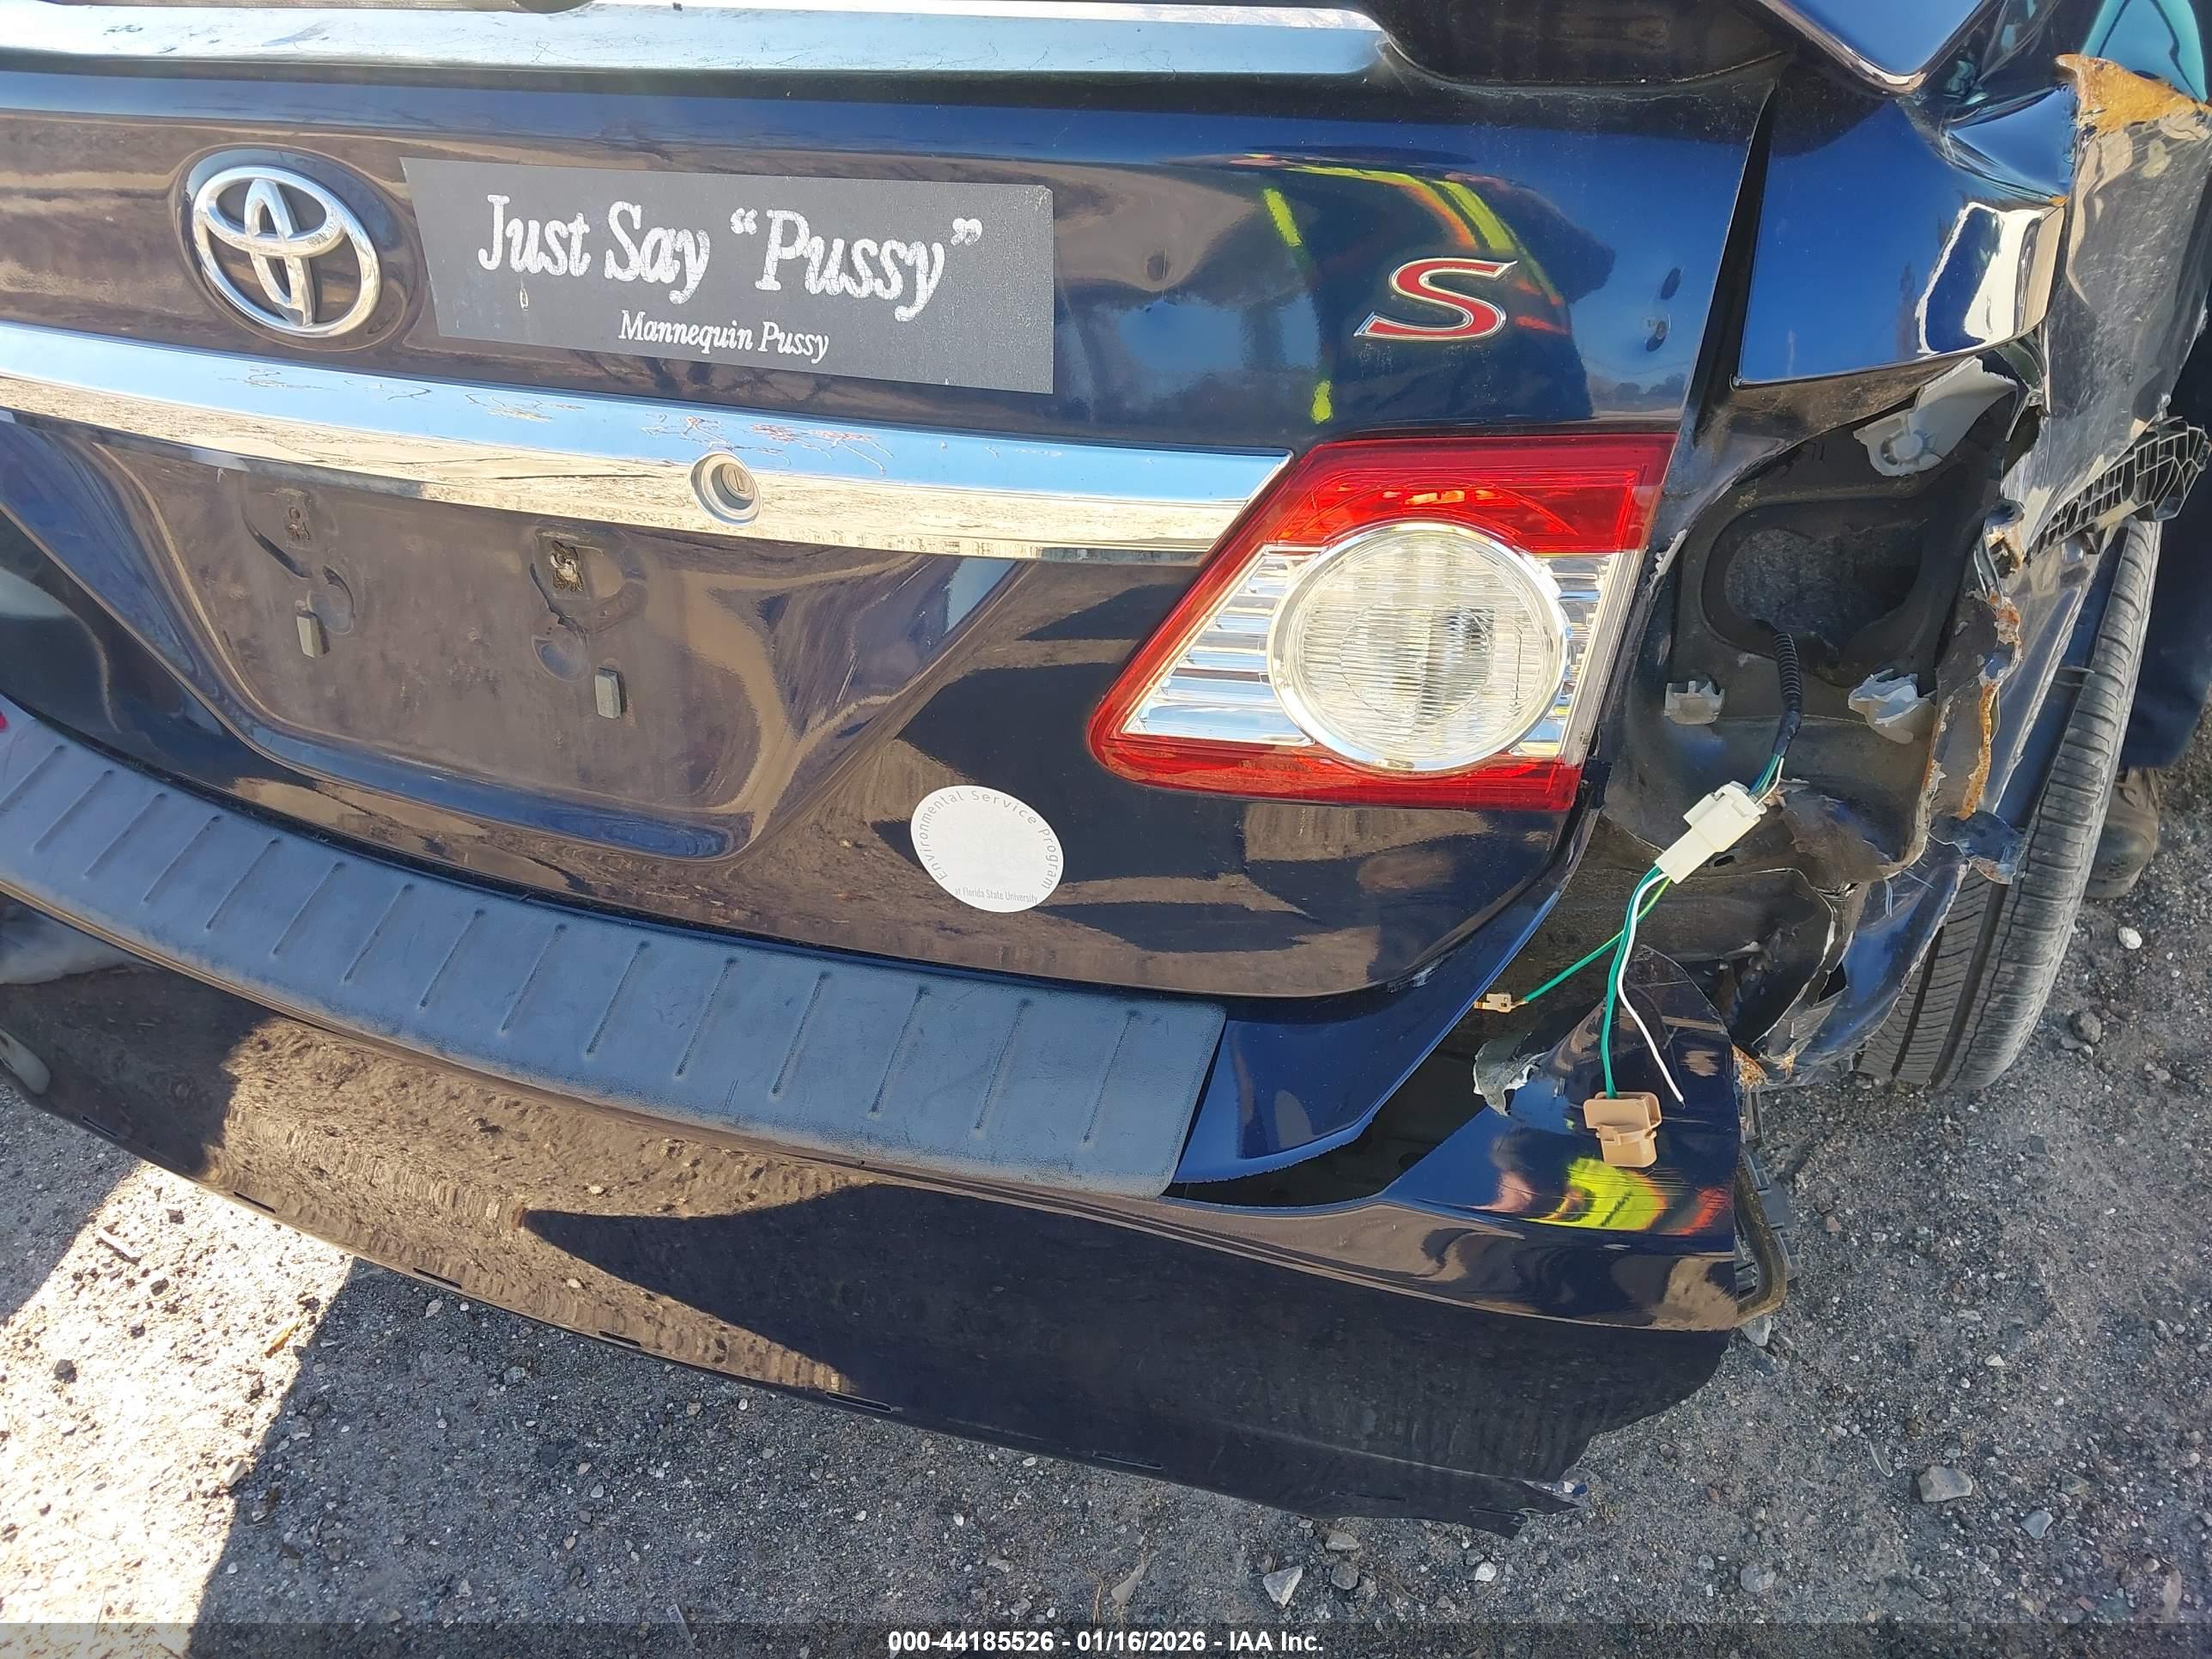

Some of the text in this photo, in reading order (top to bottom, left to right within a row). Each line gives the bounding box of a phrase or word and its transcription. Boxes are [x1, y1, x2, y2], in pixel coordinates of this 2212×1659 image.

[477, 194, 983, 321] Just Say “Pussy”
[618, 309, 830, 364] Mannequin Pussy
[1353, 258, 1518, 341] S
[920, 790, 1059, 889] Environmental Service Program
[963, 886, 984, 898] Florida
[987, 890, 1003, 900] State
[1005, 891, 1038, 903] University
